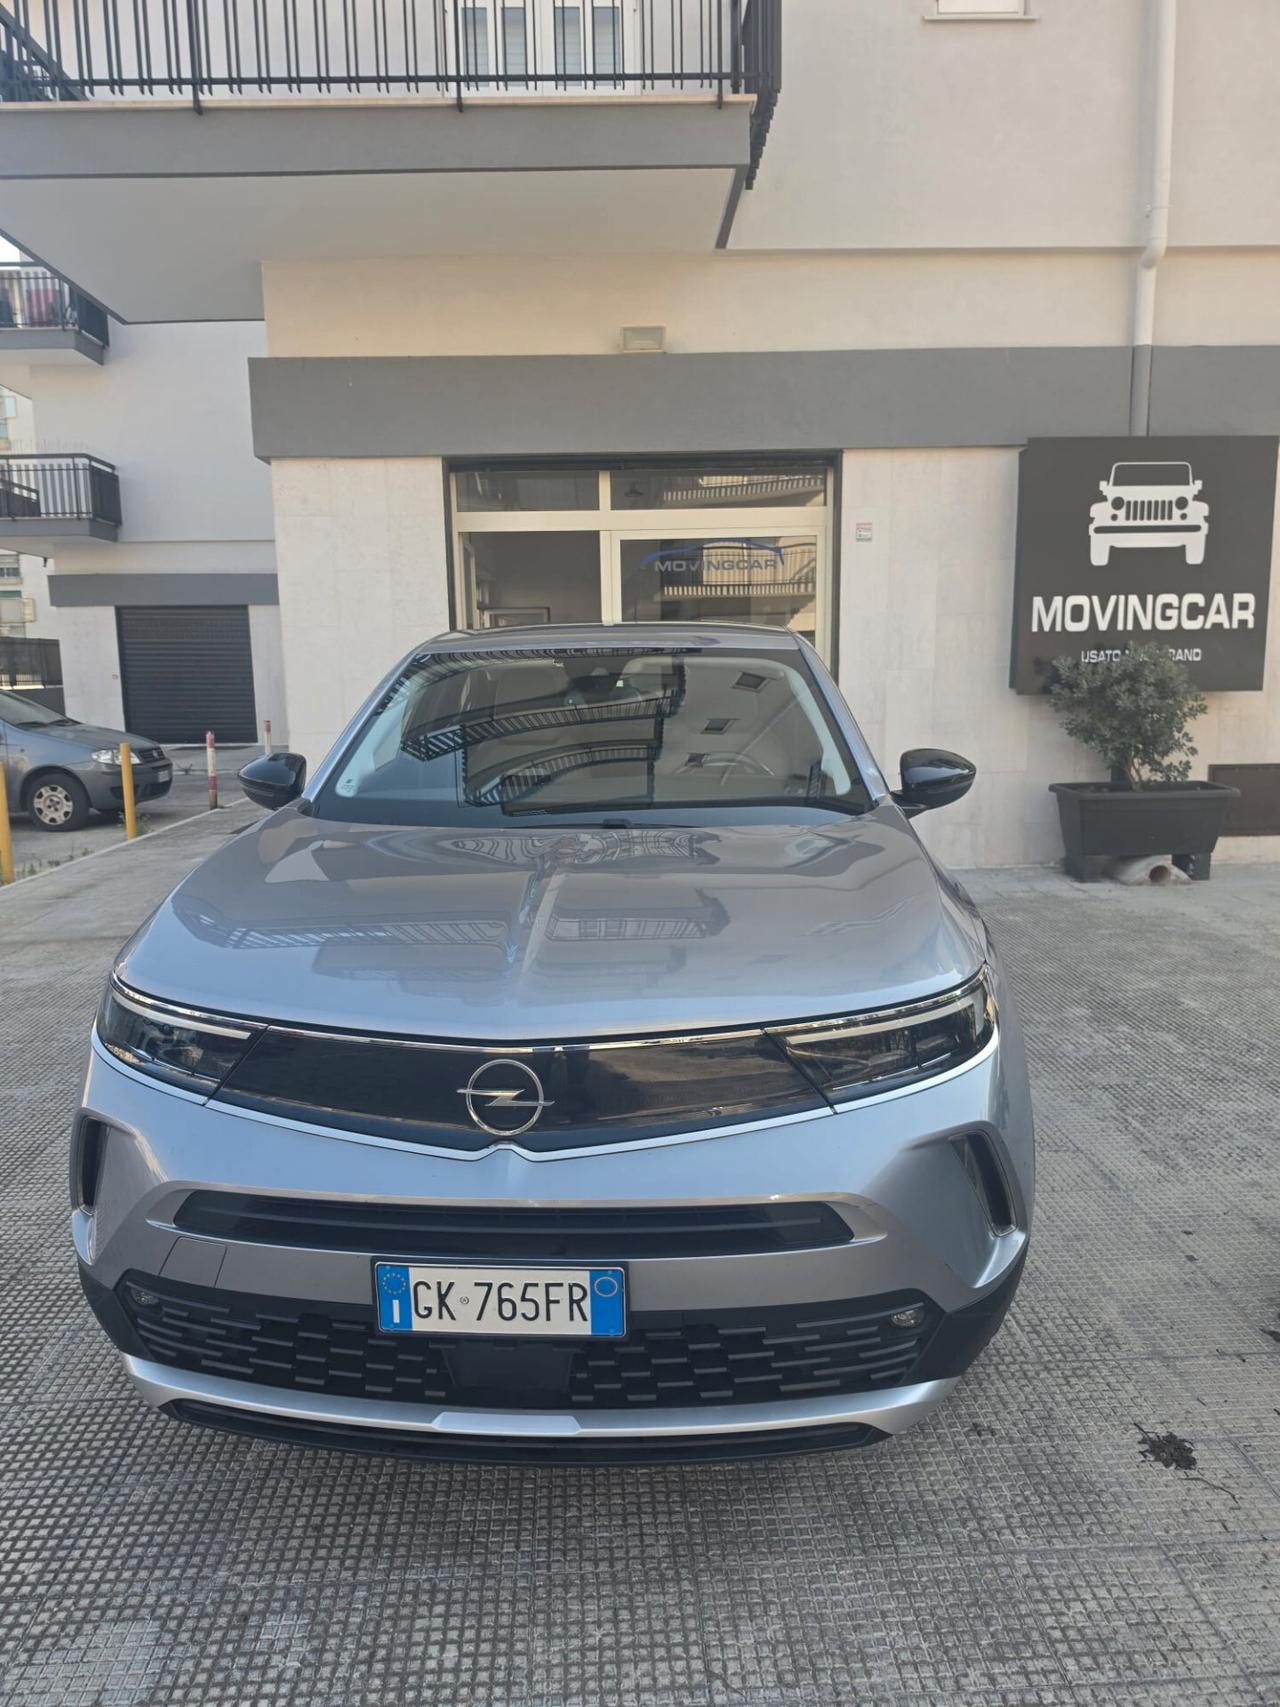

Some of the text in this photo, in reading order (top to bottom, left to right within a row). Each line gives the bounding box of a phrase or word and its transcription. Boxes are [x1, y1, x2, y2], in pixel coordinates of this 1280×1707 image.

[654, 559, 777, 573] MOVINGCAR
[1031, 593, 1255, 632] MOVINGCAR
[1080, 649, 1122, 663] USATO
[412, 1280, 588, 1322] GK 765FR
